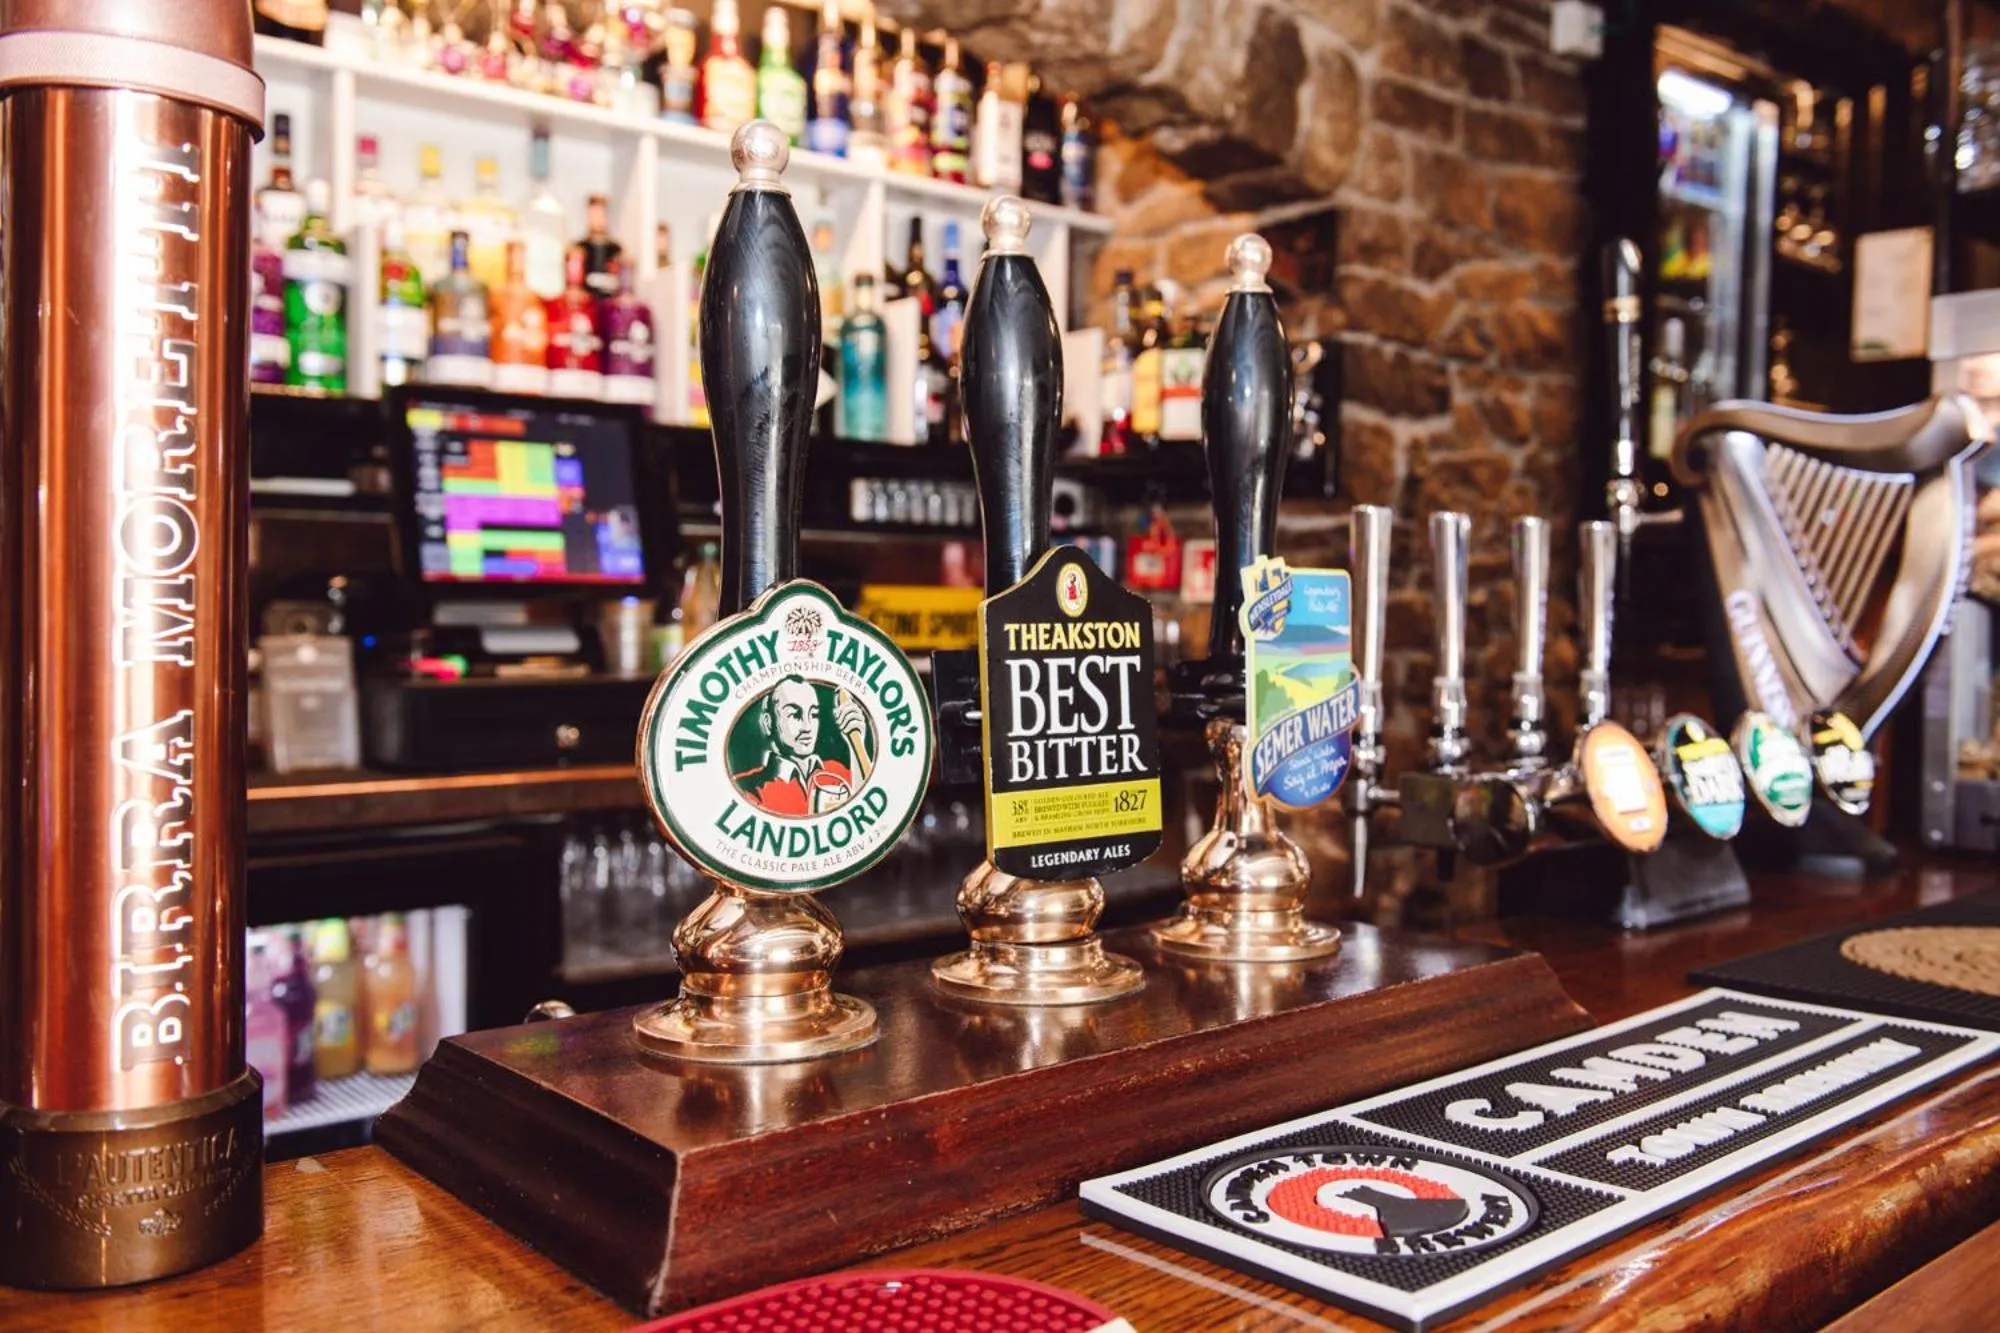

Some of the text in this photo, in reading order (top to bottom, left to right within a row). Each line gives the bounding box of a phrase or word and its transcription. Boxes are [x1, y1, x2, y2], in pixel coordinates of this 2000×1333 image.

[1004, 622, 1140, 651] THEAKSTON
[675, 630, 917, 772] TIMOTHY TAYLOR'S
[735, 662, 870, 699] CHAMPIONSHIP BEERS
[1005, 655, 1141, 737] BEST
[1008, 733, 1148, 783] BITTER
[1256, 688, 1357, 784] SEMER WATER
[714, 786, 888, 857] LANDLORD
[1114, 789, 1147, 812] 1827
[716, 839, 737, 859] THE
[740, 853, 787, 873] CLASSIC
[791, 861, 818, 873] PALE
[823, 855, 842, 869] ALE
[845, 842, 866, 859] ABV
[1031, 844, 1131, 869] LEGENDARY ALES
[111, 710, 194, 1072] BIRRA
[1445, 1011, 1800, 1132] CAMDEN
